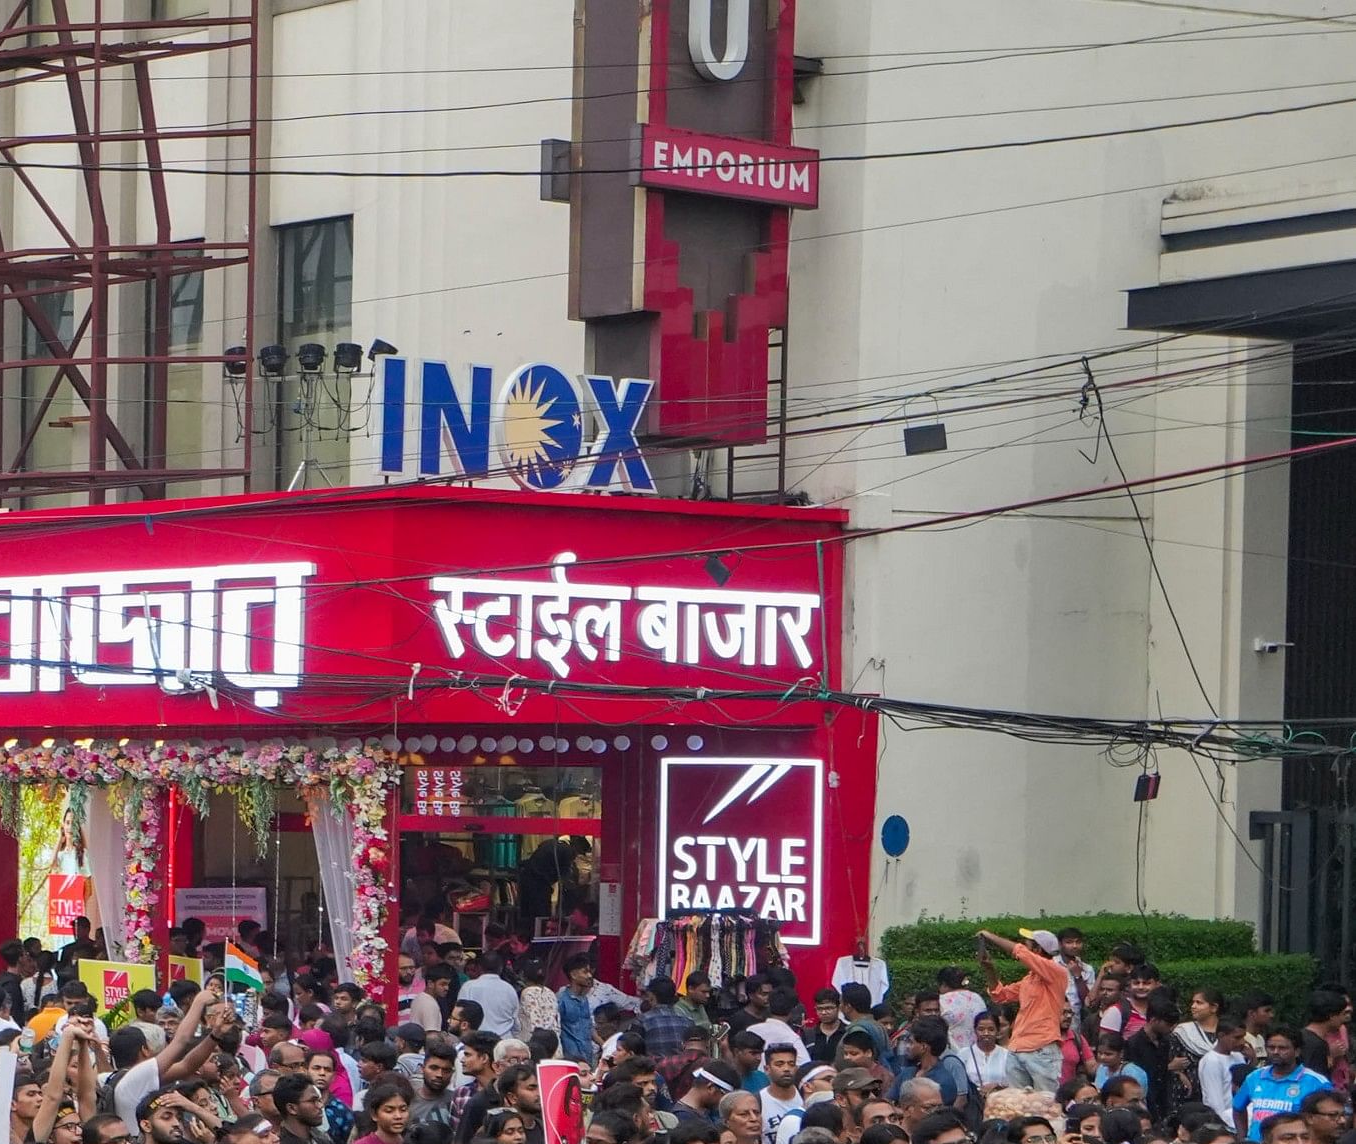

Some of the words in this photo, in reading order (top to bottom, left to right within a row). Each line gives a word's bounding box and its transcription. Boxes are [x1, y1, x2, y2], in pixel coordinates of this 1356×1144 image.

[653, 141, 810, 194] EMPORIUM
[379, 356, 658, 494] INOX
[638, 584, 821, 670] बाजार
[672, 835, 807, 884] STYLE
[50, 898, 83, 915] STYLE
[670, 885, 807, 923] BAAZAR
[104, 988, 129, 999] STYLE
